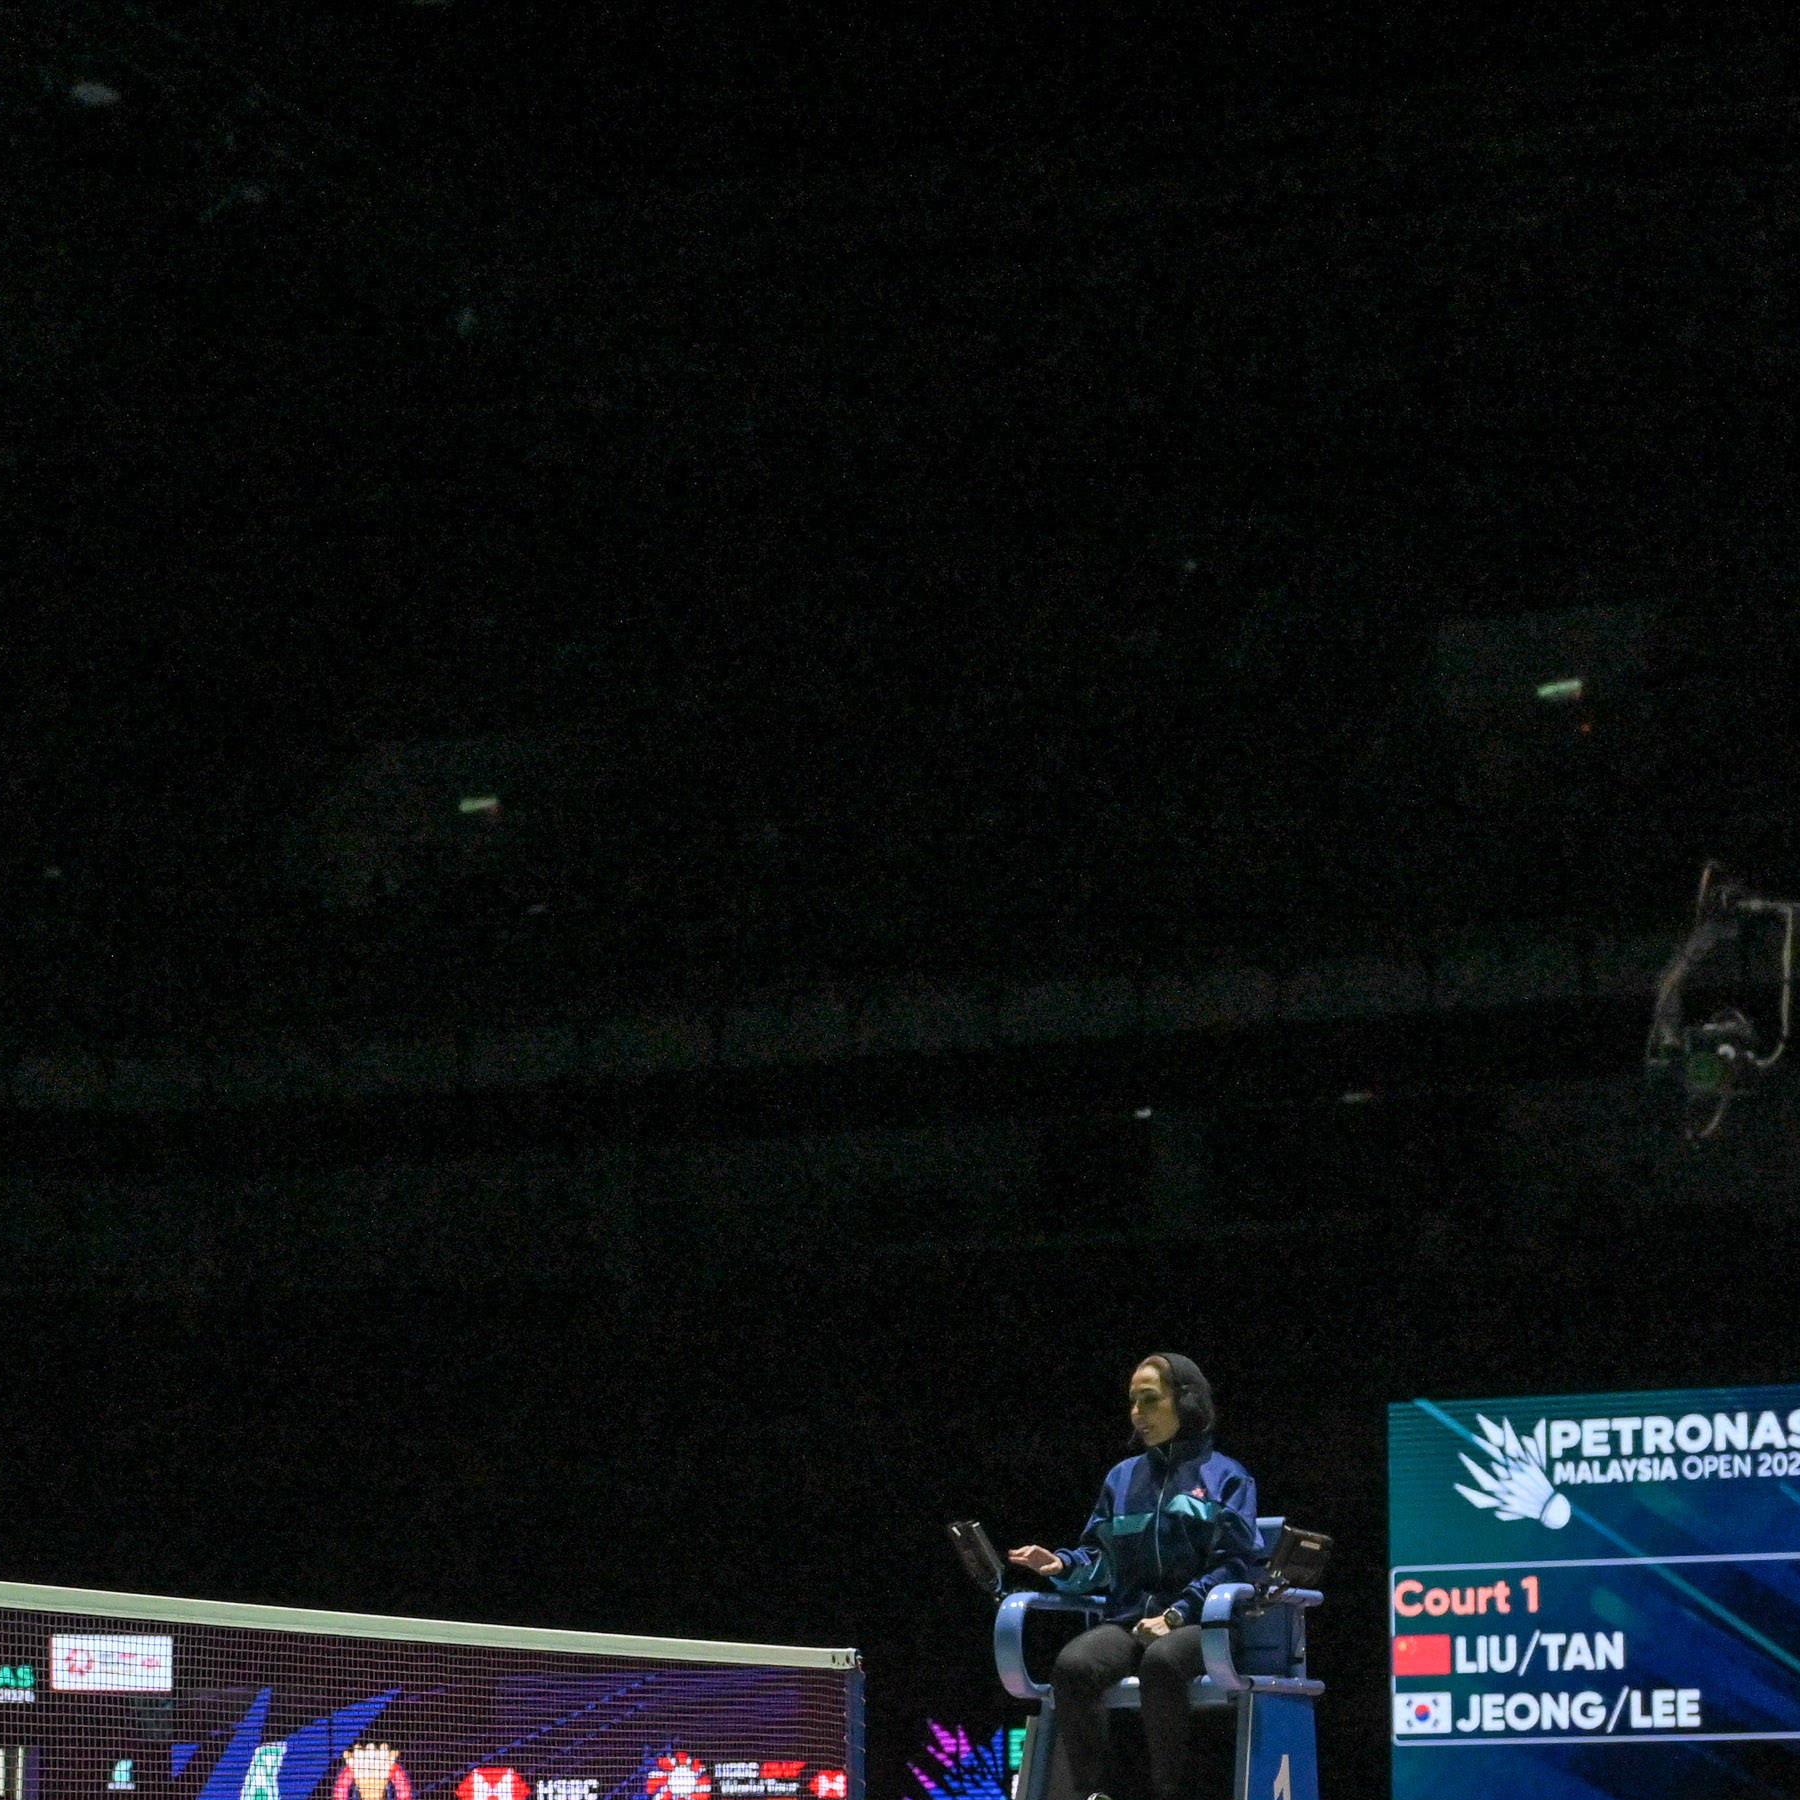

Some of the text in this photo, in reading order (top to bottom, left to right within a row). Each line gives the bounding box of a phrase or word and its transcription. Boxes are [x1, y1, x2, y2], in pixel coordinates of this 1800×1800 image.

[1553, 1454, 1677, 1485] MALAYSIA
[1683, 1455, 1751, 1480] OPEN
[1393, 1576, 1540, 1617] Court 1
[1455, 1630, 1624, 1677] LIU/TAN
[1456, 1686, 1701, 1733] JEONG/LEE
[537, 1779, 599, 1800] HSBC
